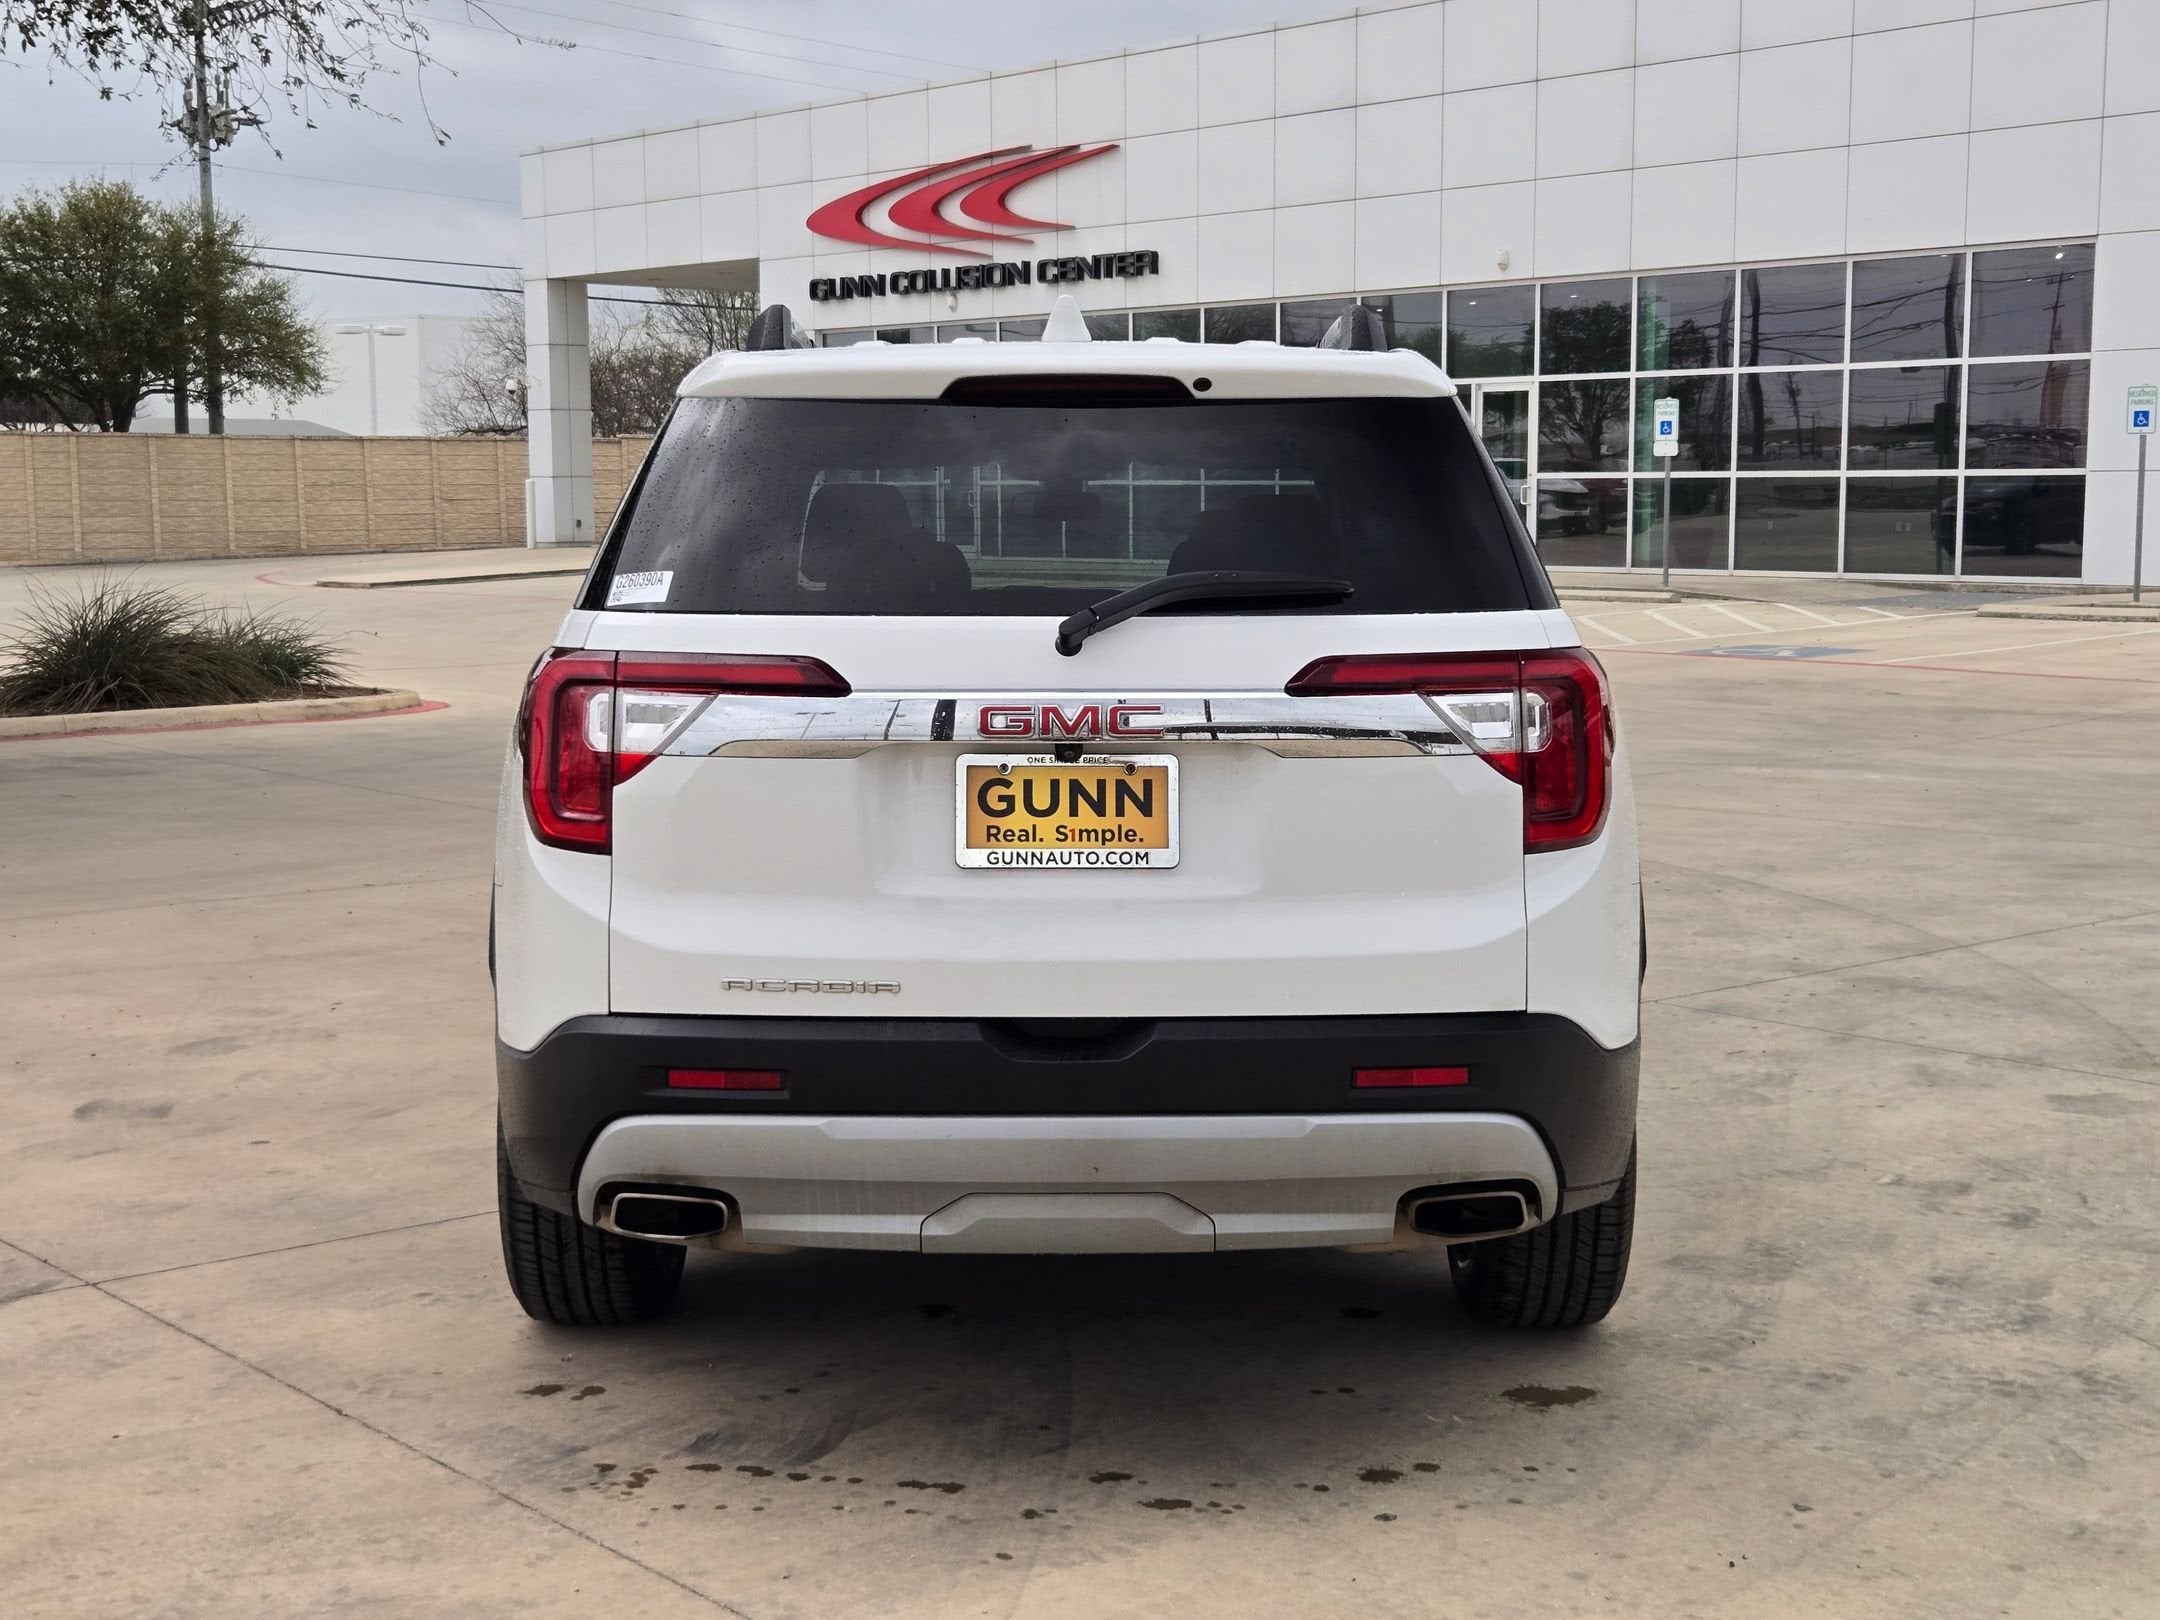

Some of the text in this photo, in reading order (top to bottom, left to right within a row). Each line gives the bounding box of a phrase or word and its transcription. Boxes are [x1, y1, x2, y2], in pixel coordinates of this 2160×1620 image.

[809, 250, 1160, 301] GUNN COLLISION CENTER
[616, 571, 664, 589] G260390A
[977, 704, 1165, 738] GMC
[1026, 756, 1046, 764] ONE
[1082, 756, 1109, 764] PRICE
[977, 777, 1153, 818] GUNN
[986, 825, 1044, 842] Real.
[986, 851, 1149, 865] GUNNAUTO.COM
[720, 977, 901, 993] ACADIA
